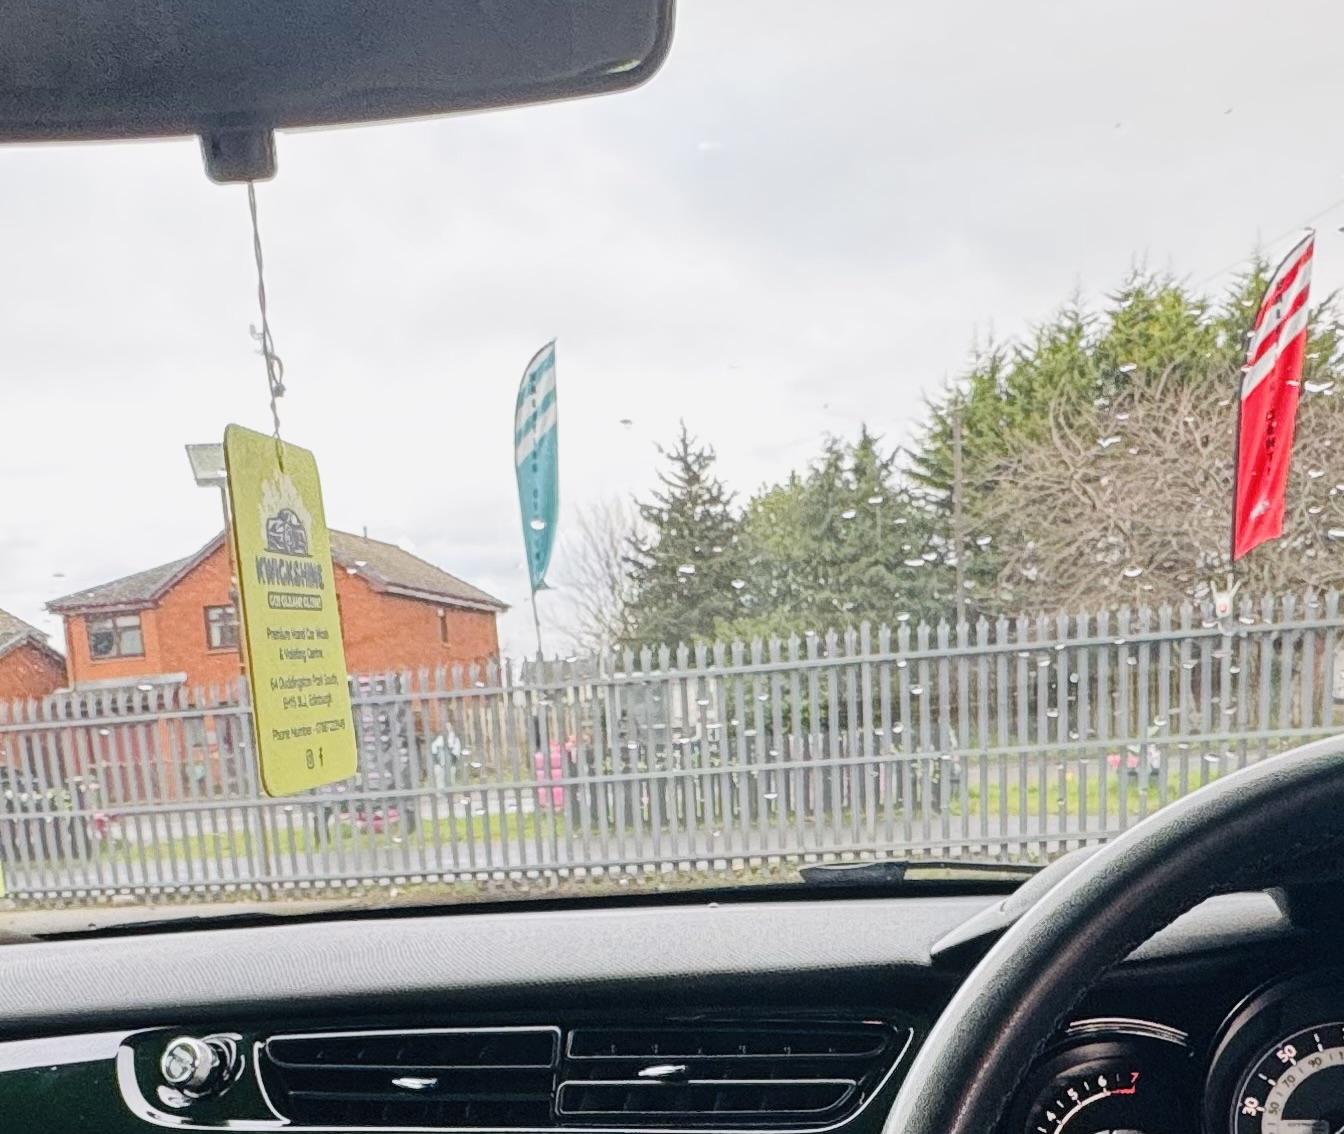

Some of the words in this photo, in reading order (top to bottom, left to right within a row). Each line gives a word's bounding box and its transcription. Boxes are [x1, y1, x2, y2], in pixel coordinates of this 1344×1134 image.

[1276, 1044, 1297, 1063] 50
[1308, 1056, 1322, 1068] 90
[1098, 1075, 1107, 1087] 6
[1130, 1072, 1139, 1083] 7
[1282, 1074, 1296, 1088] 70
[1067, 1088, 1078, 1100] 5
[1242, 1097, 1260, 1116] 30
[1268, 1101, 1279, 1115] 50
[1047, 1110, 1056, 1121] 4
